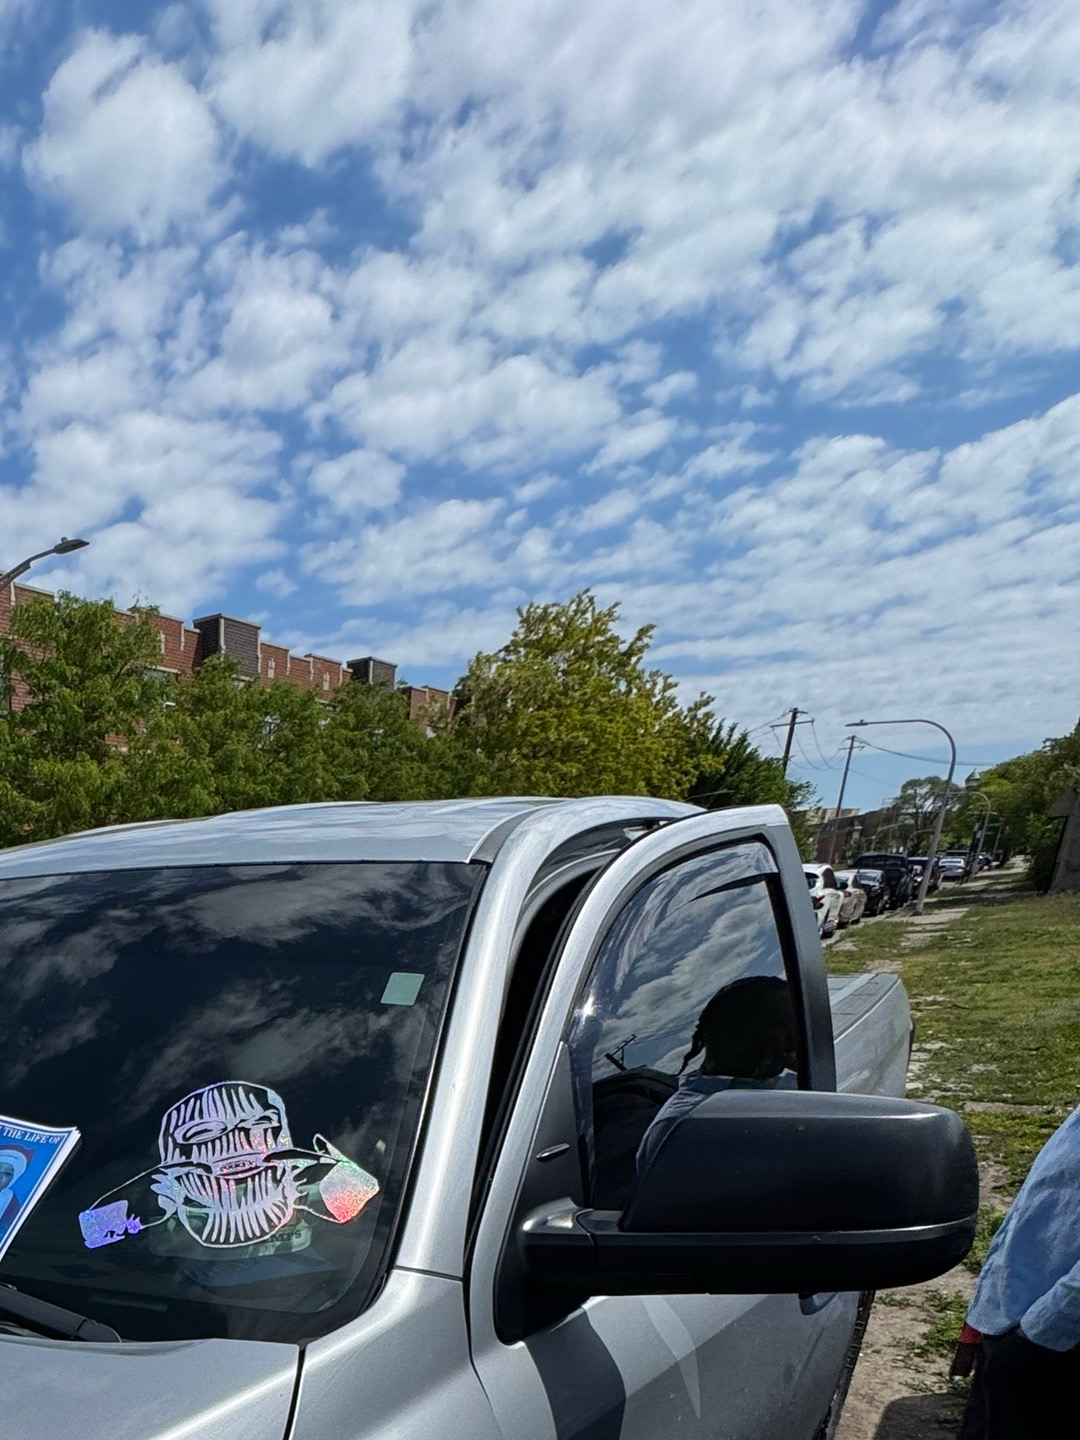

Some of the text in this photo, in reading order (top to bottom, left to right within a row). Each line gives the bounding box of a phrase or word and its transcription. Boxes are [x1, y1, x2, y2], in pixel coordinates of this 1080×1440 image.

[3, 1126, 24, 1139] THE
[24, 1131, 51, 1144] LIFE
[49, 1135, 62, 1144] OF
